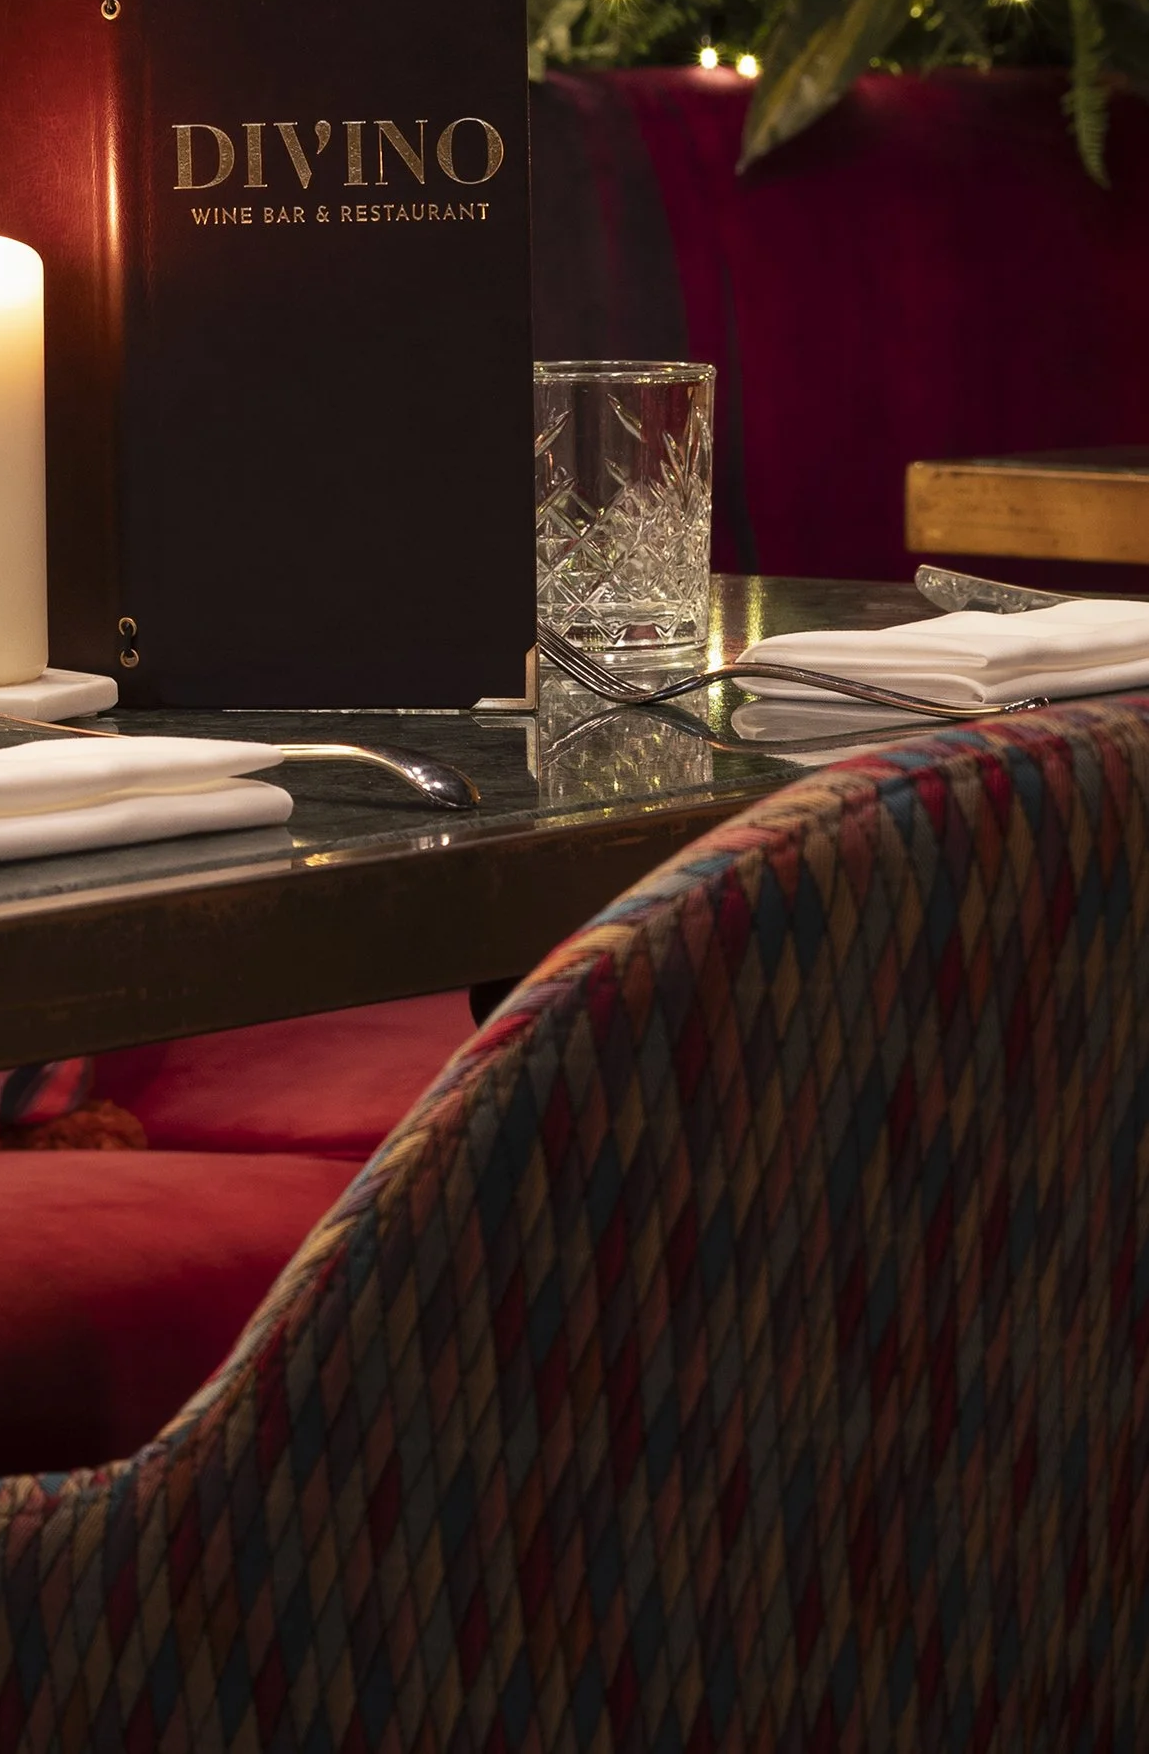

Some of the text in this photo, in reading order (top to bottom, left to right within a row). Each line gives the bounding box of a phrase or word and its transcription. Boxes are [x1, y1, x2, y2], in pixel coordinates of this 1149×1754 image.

[191, 203, 490, 225] WINE BAR & RESTAURANT
